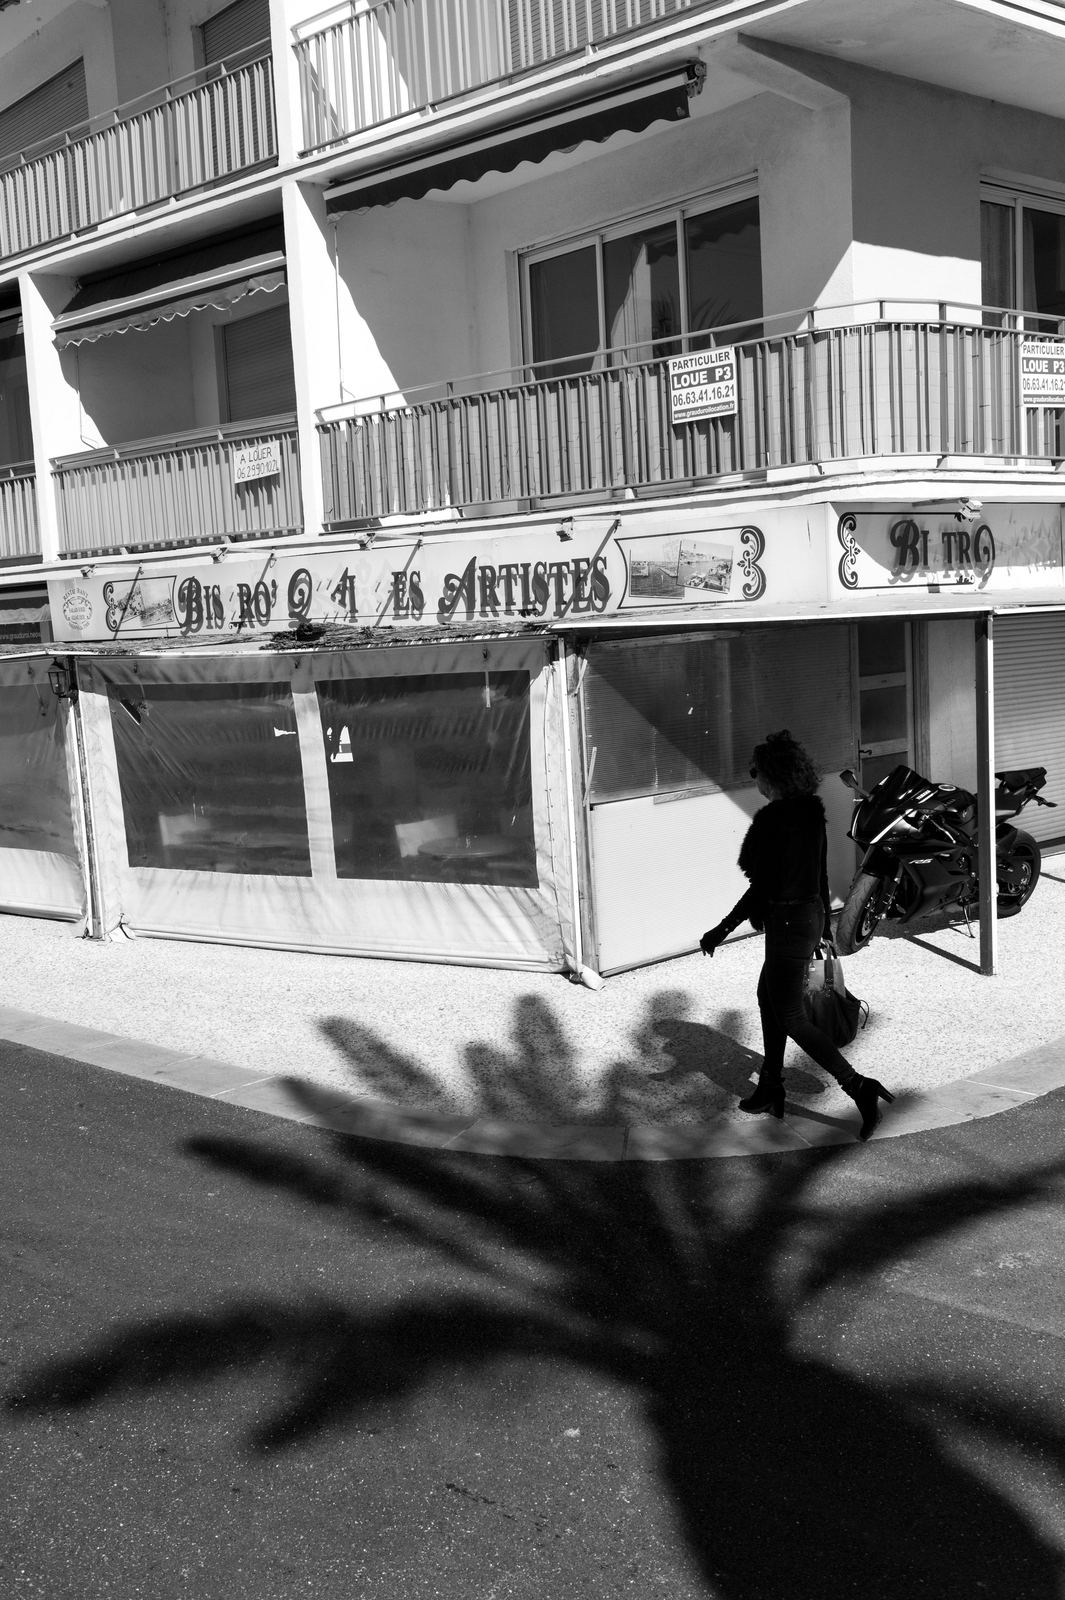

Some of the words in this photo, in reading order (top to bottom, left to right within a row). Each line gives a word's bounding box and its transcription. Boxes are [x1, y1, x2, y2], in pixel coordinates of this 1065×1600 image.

[1023, 344, 1065, 355] PARTICULIER
[672, 351, 730, 371] PARTICULIER
[1023, 360, 1048, 373] LOUE
[1053, 361, 1065, 373] P3
[673, 370, 708, 389] LOUE
[715, 366, 732, 381] P3
[1023, 378, 1065, 391] 06.63.41.16.2
[673, 384, 735, 407] 06.63.41.16.21
[240, 454, 246, 465] A
[249, 446, 273, 463] LOUER
[438, 556, 612, 622] ARTISTES
